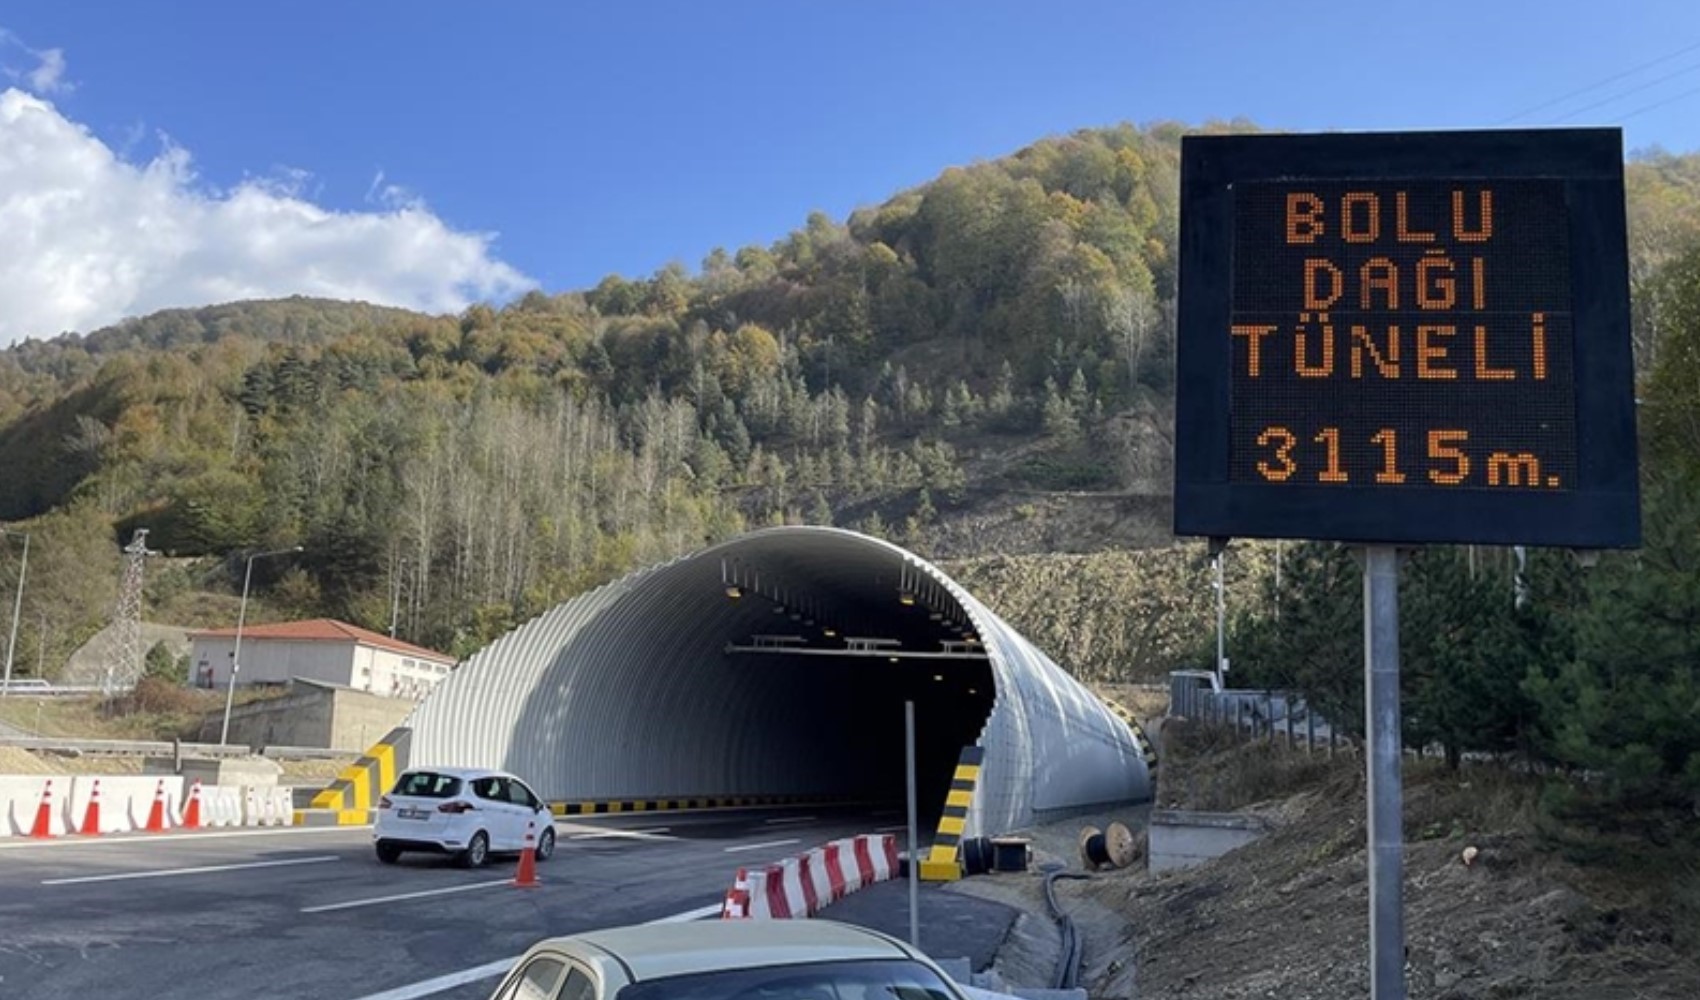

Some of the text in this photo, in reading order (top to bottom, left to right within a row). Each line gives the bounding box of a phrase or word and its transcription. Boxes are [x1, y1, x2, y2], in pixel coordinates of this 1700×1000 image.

[1286, 190, 1493, 244] BOLU
[1304, 249, 1485, 310] DAĞI
[1230, 312, 1547, 379] TÜNELİ
